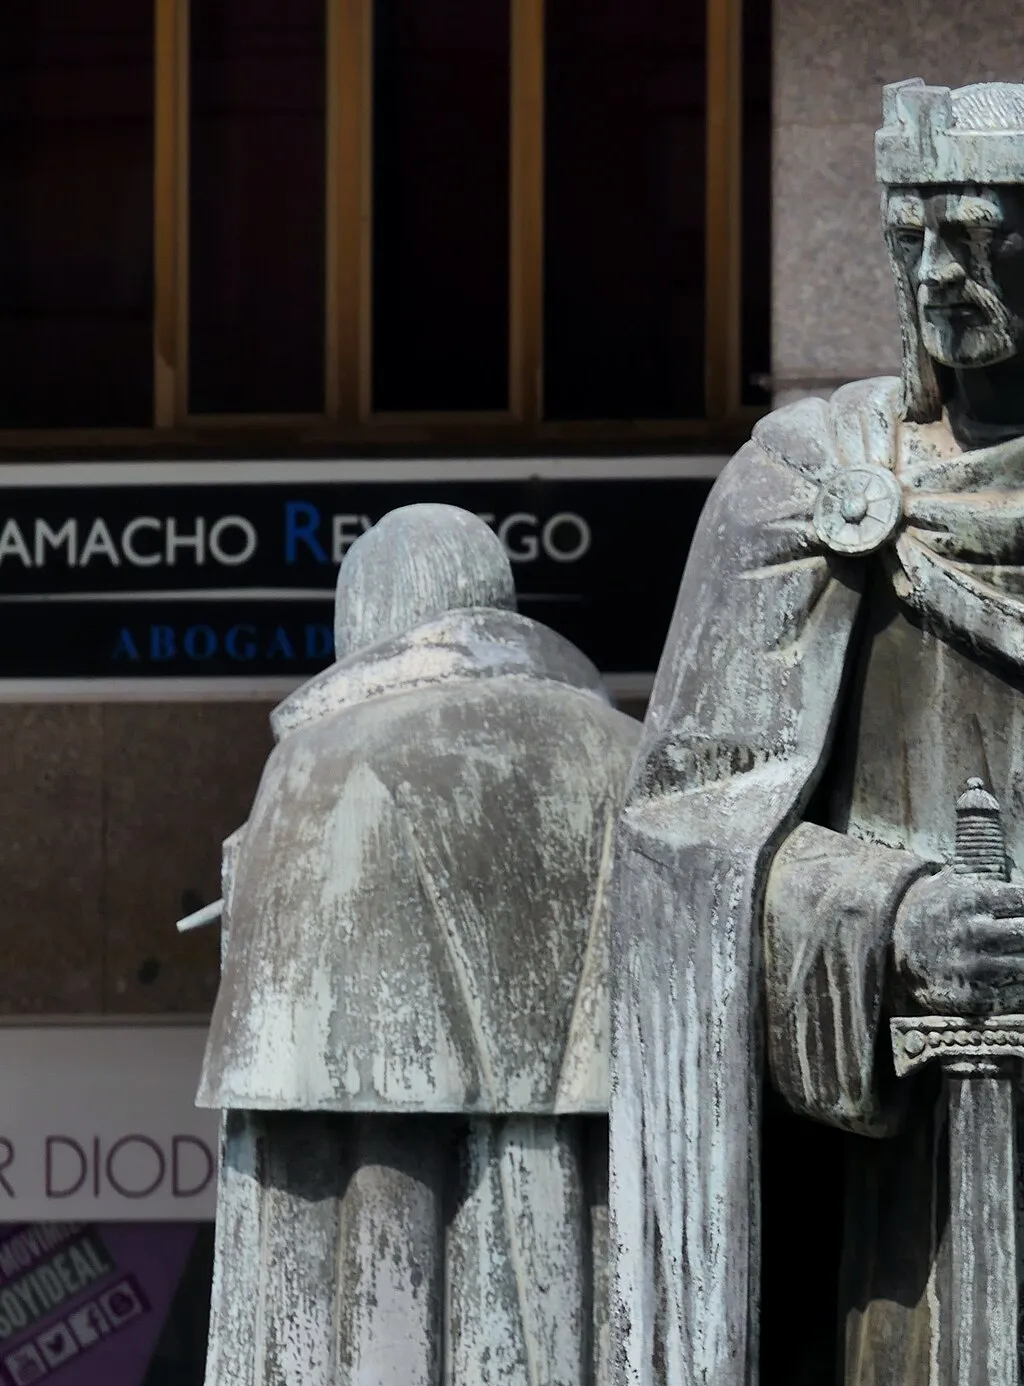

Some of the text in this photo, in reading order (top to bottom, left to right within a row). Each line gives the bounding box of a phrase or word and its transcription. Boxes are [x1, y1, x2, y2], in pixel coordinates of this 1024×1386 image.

[0, 516, 258, 567] AMACHO
[110, 624, 334, 661] ABOGAD
[45, 1134, 215, 1198] DIOD
